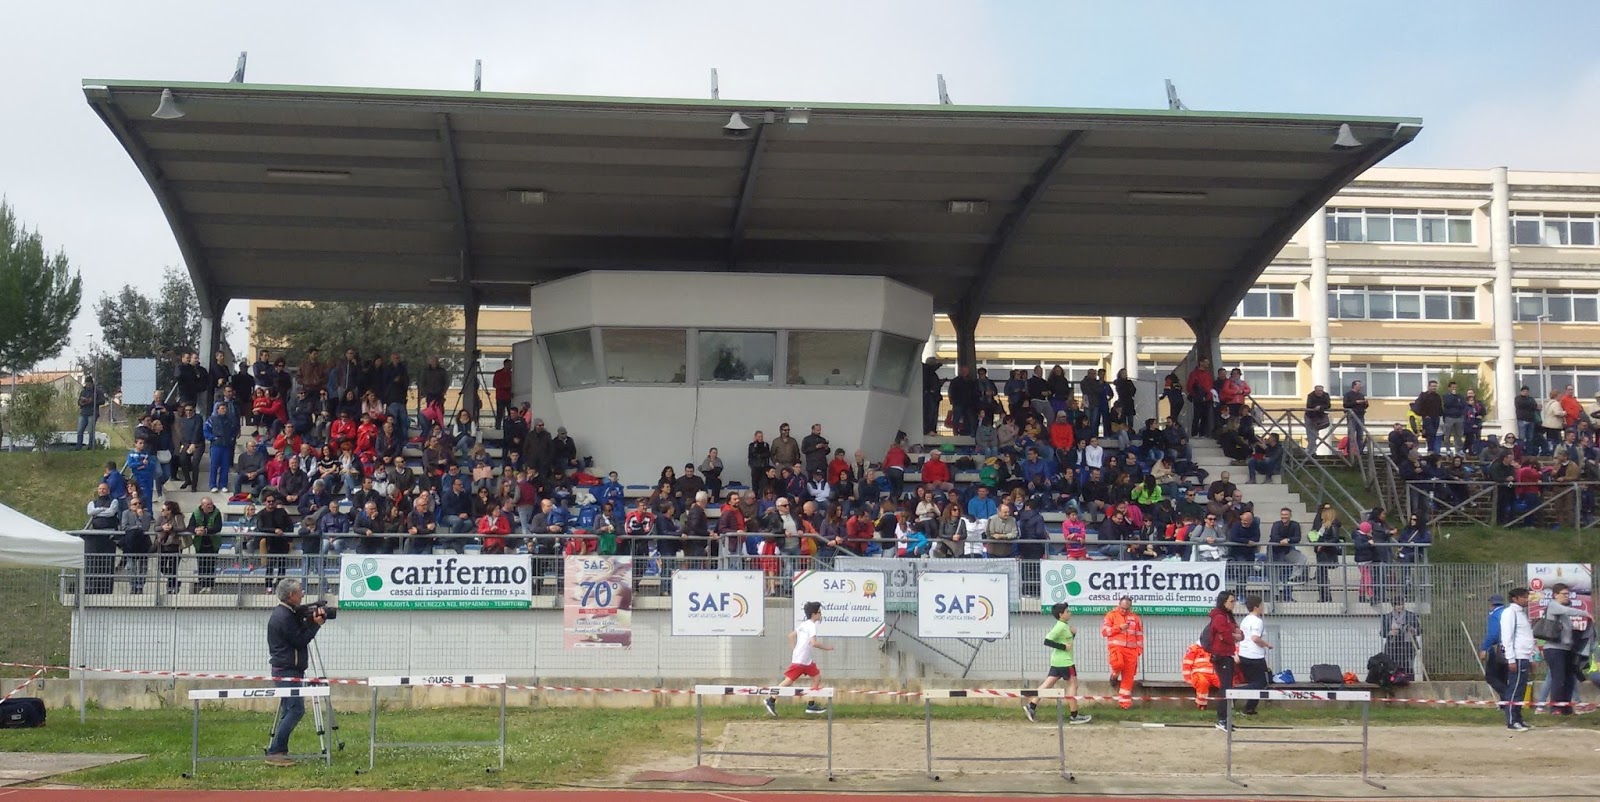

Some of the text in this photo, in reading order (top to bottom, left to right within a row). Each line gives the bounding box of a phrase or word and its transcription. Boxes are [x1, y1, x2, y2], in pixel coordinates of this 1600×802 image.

[584, 560, 605, 569] SAF
[390, 558, 527, 585] carifermo
[1088, 564, 1220, 591] carifermo
[823, 579, 846, 590] SAF
[389, 589, 413, 597] cassa
[414, 587, 424, 596] di
[425, 587, 469, 598] risparmio
[470, 587, 479, 596] di
[481, 587, 508, 596] fermo
[1088, 593, 1110, 601] cassa
[1112, 592, 1122, 601] di
[1123, 593, 1164, 603] risparmio
[1165, 592, 1174, 601] di
[1176, 592, 1201, 602] fermo
[689, 592, 730, 612] SAF
[934, 594, 976, 614] SAF
[820, 613, 850, 623] rande
[435, 676, 454, 684] UCS
[243, 689, 276, 697] UCS
